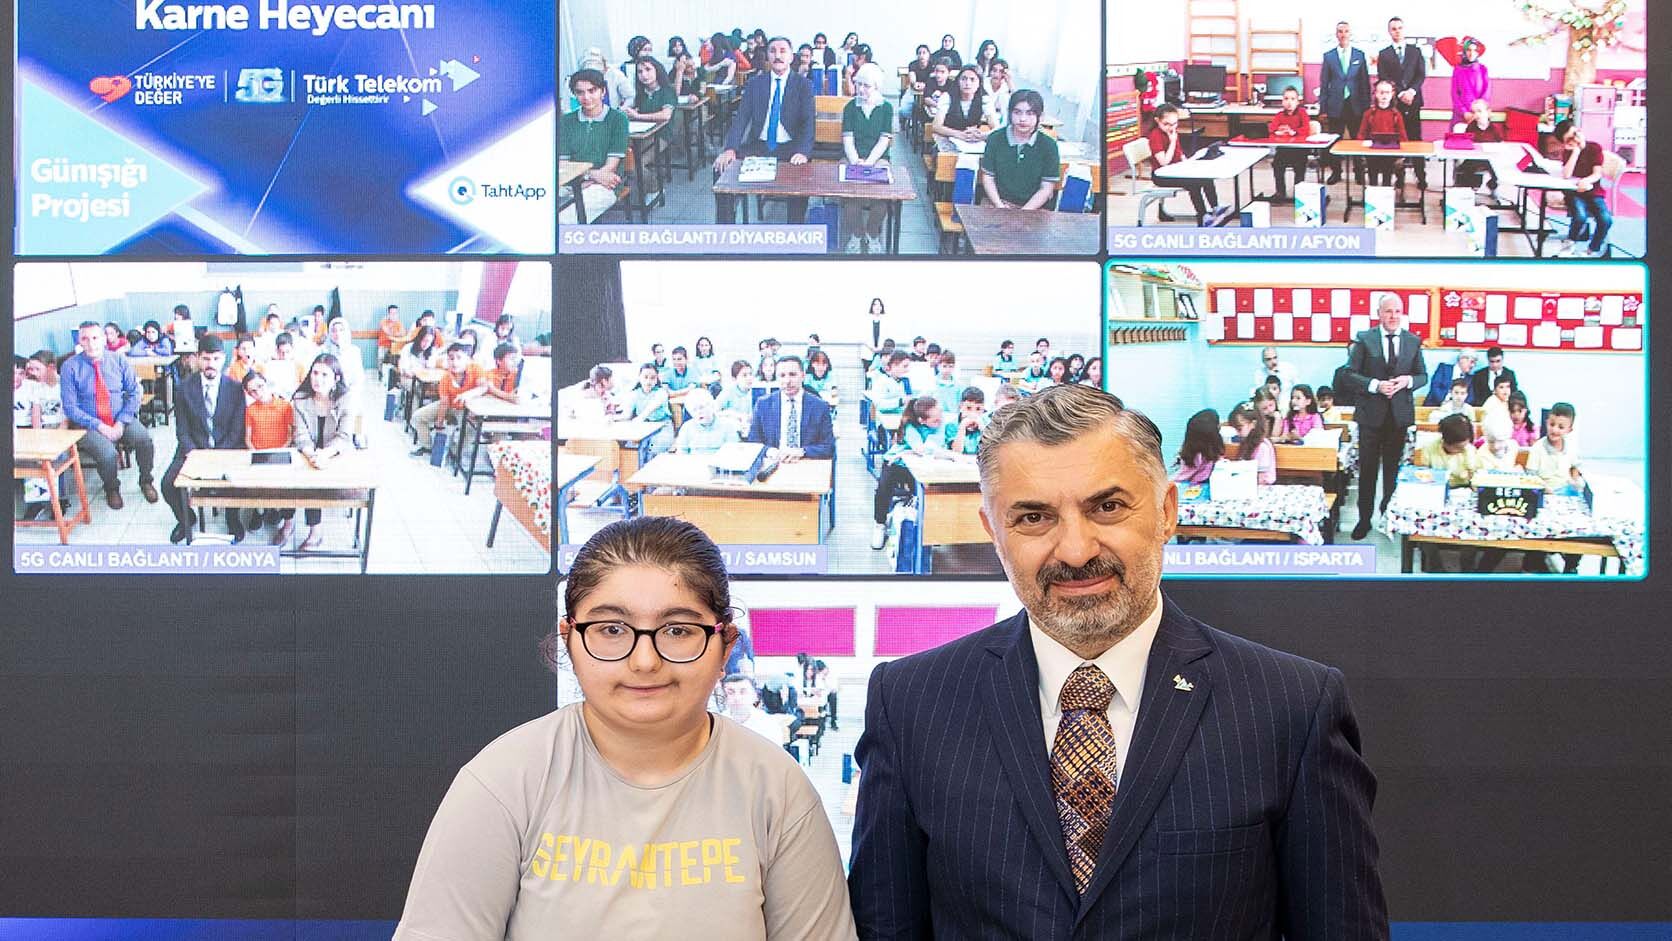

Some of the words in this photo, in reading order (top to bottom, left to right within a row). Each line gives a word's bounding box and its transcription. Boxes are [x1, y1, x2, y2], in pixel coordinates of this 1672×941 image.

[135, 0, 249, 30] Karne
[259, 0, 435, 36] Heyecanı
[134, 72, 216, 90] TÜRKİYE'YE
[303, 75, 349, 94] Türk
[354, 75, 442, 94] Telekom
[134, 88, 183, 105] DEĞER
[30, 156, 148, 189] Günışığı
[481, 183, 547, 200] TahtApp
[31, 191, 131, 223] Projesi
[564, 231, 585, 245] 5G
[588, 231, 635, 245] CANLI
[639, 228, 718, 245] BAĞLANTI
[729, 228, 824, 245] DİYARBAKIR
[1113, 233, 1137, 249] 5G
[1141, 233, 1195, 249] CANLI
[1199, 231, 1288, 249] BAĞLANTI
[1300, 233, 1361, 249] AFYON
[20, 551, 45, 568] 5G
[48, 551, 104, 568] CANLI
[108, 549, 200, 568] BAĞLANTI
[213, 551, 276, 568] KONYA
[745, 551, 817, 567] SAMSUN
[1163, 551, 1192, 566] NLI
[1194, 548, 1282, 567] BAĞLANTI
[1293, 551, 1364, 567] ISPARTA
[532, 832, 746, 889] SEYRANTEPE
